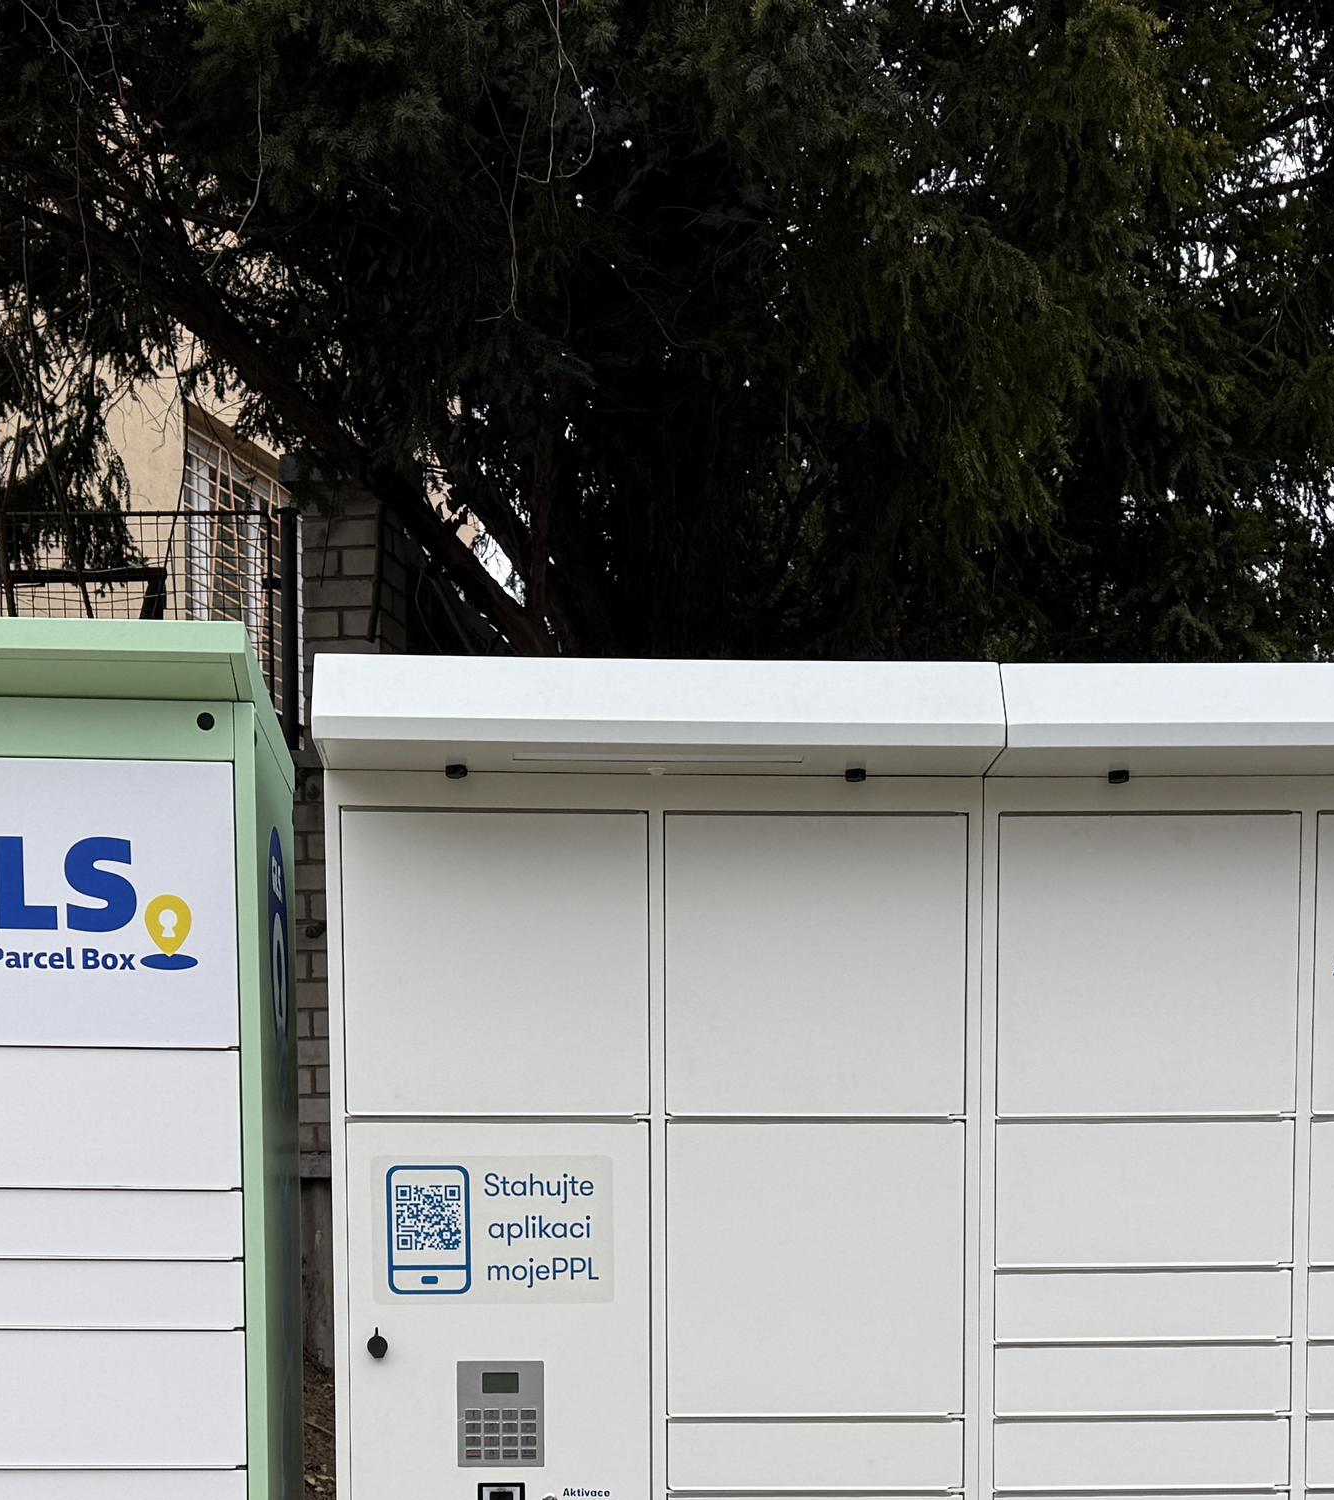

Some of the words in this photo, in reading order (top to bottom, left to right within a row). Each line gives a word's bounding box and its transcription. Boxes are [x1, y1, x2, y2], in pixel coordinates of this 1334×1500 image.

[82, 948, 137, 971] Box
[483, 1172, 595, 1204] Stahujte
[488, 1214, 591, 1246] aplikaci
[487, 1256, 600, 1289] mojePPL
[562, 1487, 611, 1498] Aktivace
